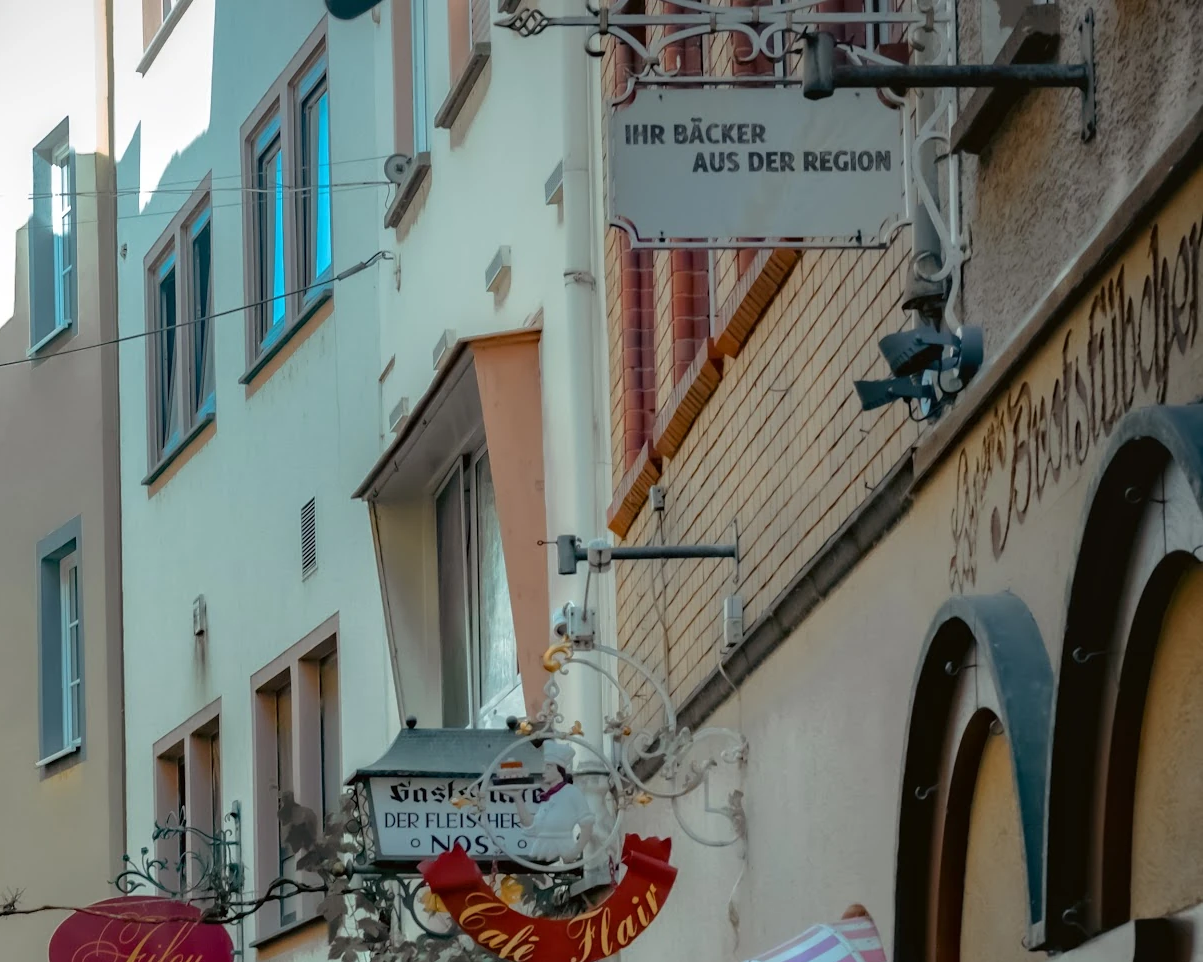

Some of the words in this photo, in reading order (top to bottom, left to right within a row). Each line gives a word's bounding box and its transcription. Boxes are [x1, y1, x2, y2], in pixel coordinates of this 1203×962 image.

[625, 124, 665, 145] IHR
[673, 117, 766, 144] BÄCKER
[692, 151, 740, 173] AUS
[748, 151, 795, 172] DER
[803, 150, 891, 172] REGION
[385, 812, 419, 828] DER
[458, 892, 540, 962] Café
